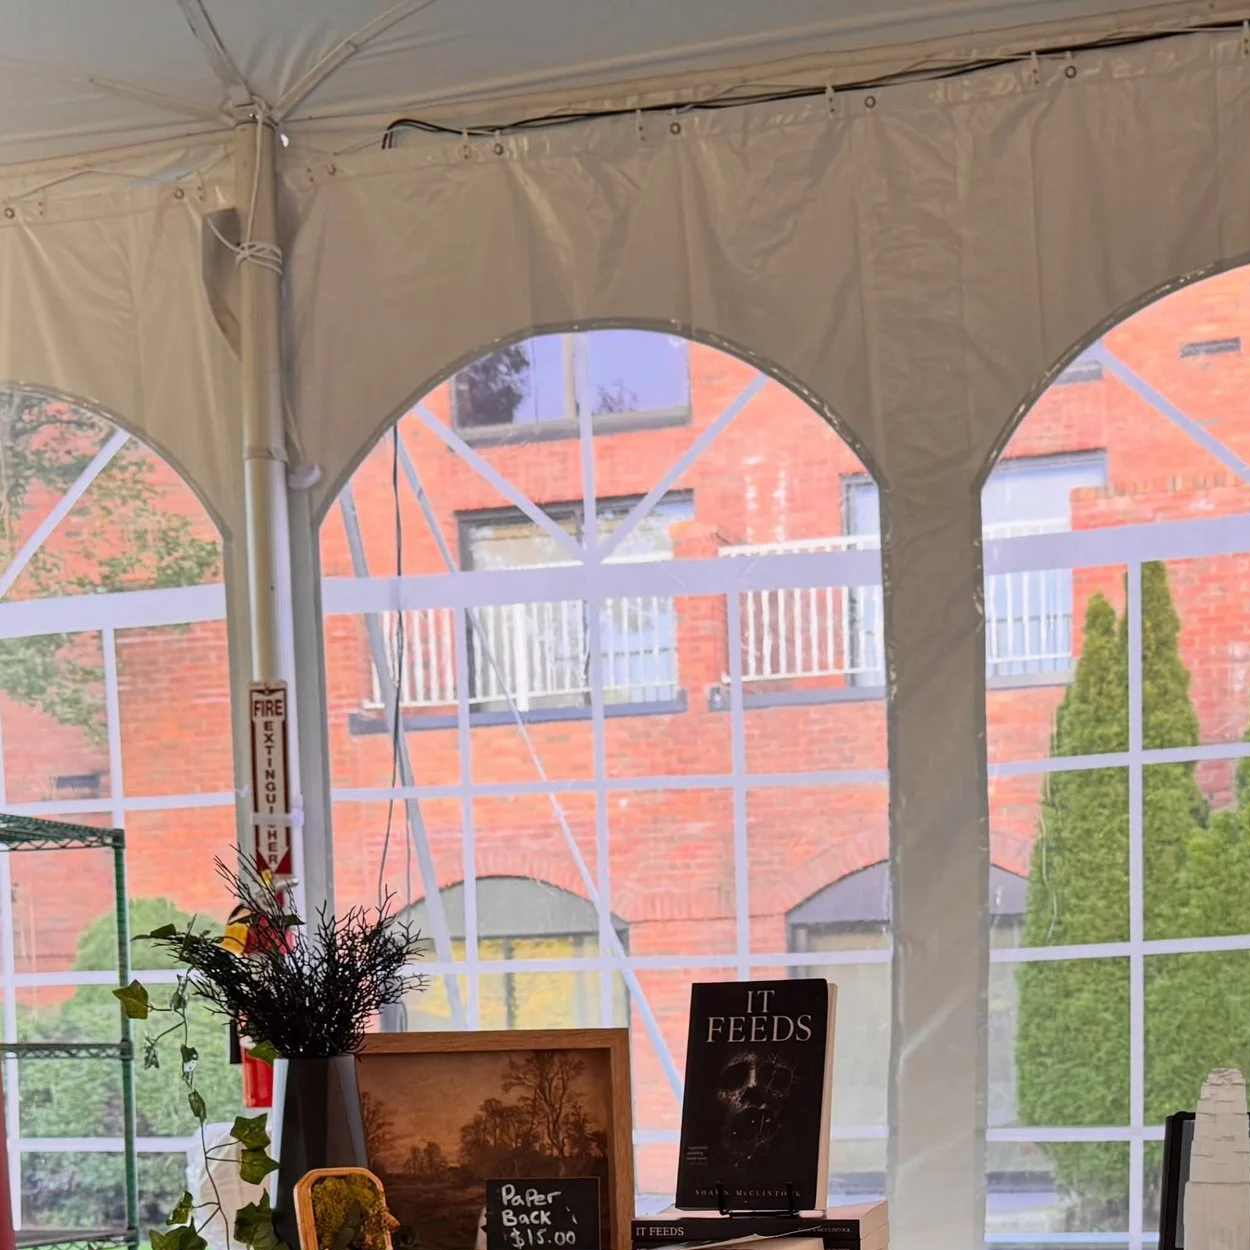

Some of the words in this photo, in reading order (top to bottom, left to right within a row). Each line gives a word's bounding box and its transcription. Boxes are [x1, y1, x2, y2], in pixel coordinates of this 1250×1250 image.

[253, 699, 283, 717] FIRE
[263, 720, 278, 865] EXTINGUIHER
[746, 990, 774, 1014] IT
[706, 1014, 813, 1043] FEEDS
[510, 1227, 576, 1249] $15.00
[636, 1226, 647, 1236] IT
[649, 1226, 685, 1236] FEEDS
